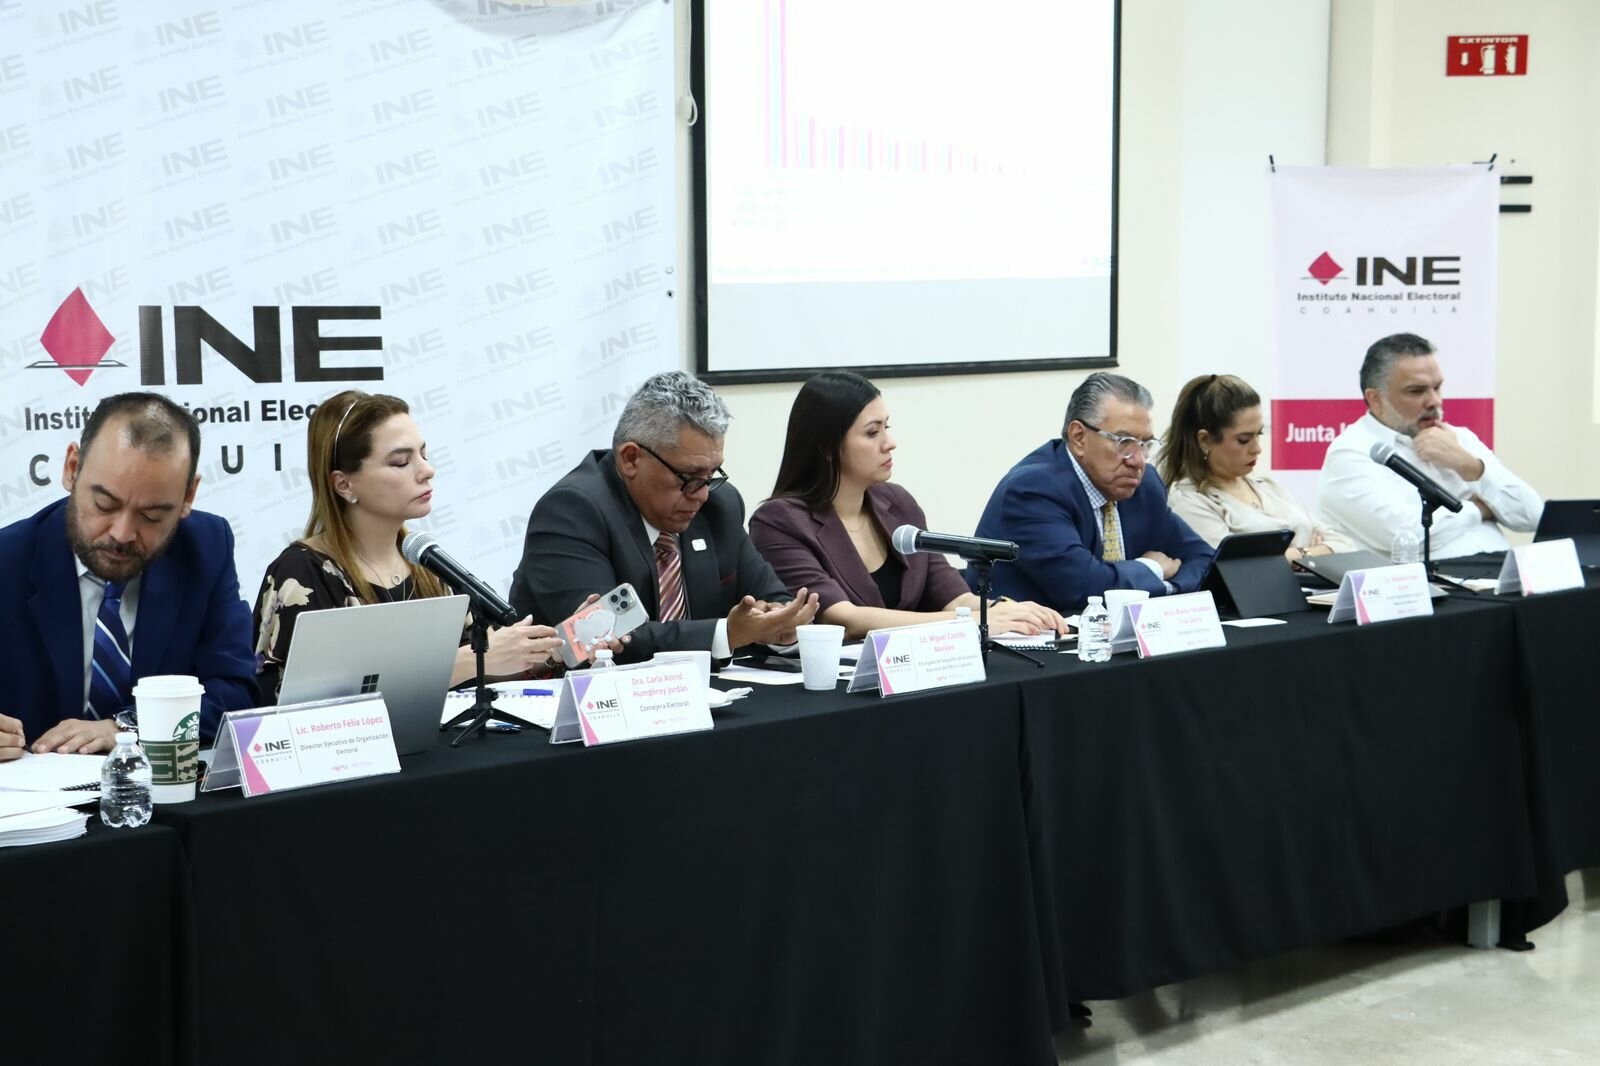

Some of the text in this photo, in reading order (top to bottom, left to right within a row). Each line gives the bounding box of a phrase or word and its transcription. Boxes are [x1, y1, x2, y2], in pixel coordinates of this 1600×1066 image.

[58, 0, 119, 35] INE
[155, 10, 222, 47] INE
[262, 20, 330, 56] INE
[370, 27, 434, 63] INE
[63, 65, 123, 103] INE
[158, 74, 226, 113] INE
[265, 81, 332, 119] INE
[371, 88, 437, 124] INE
[476, 91, 544, 129] INE
[66, 131, 127, 170] INE
[161, 138, 229, 176] INE
[268, 143, 335, 181] INE
[374, 147, 440, 185] INE
[479, 150, 548, 188] INE
[71, 198, 129, 238] INE
[164, 202, 231, 242] INE
[270, 205, 337, 244] INE
[377, 208, 443, 245] INE
[482, 208, 550, 247] INE
[601, 205, 659, 243] INE
[167, 265, 233, 305] INE
[273, 267, 340, 305] INE
[380, 268, 445, 306] INE
[485, 267, 555, 306] INE
[603, 263, 661, 301] INE
[1356, 256, 1461, 286] INE
[1297, 291, 1461, 302] Instituto Nacional Electoral
[138, 305, 384, 385] INE
[382, 328, 445, 366] INE
[484, 326, 555, 365] INE
[599, 322, 657, 360] INE
[25, 405, 90, 431] Instit
[491, 382, 563, 422] INE
[1285, 422, 1336, 443] Junta
[495, 440, 566, 481] INE
[892, 654, 910, 664] INE
[596, 699, 618, 710] INE
[295, 716, 385, 735] Lic. Roberto Félix López
[300, 741, 323, 751] Director
[323, 738, 348, 748] Ejecutivo
[264, 739, 291, 752] INE
[336, 747, 359, 755] Electoral
